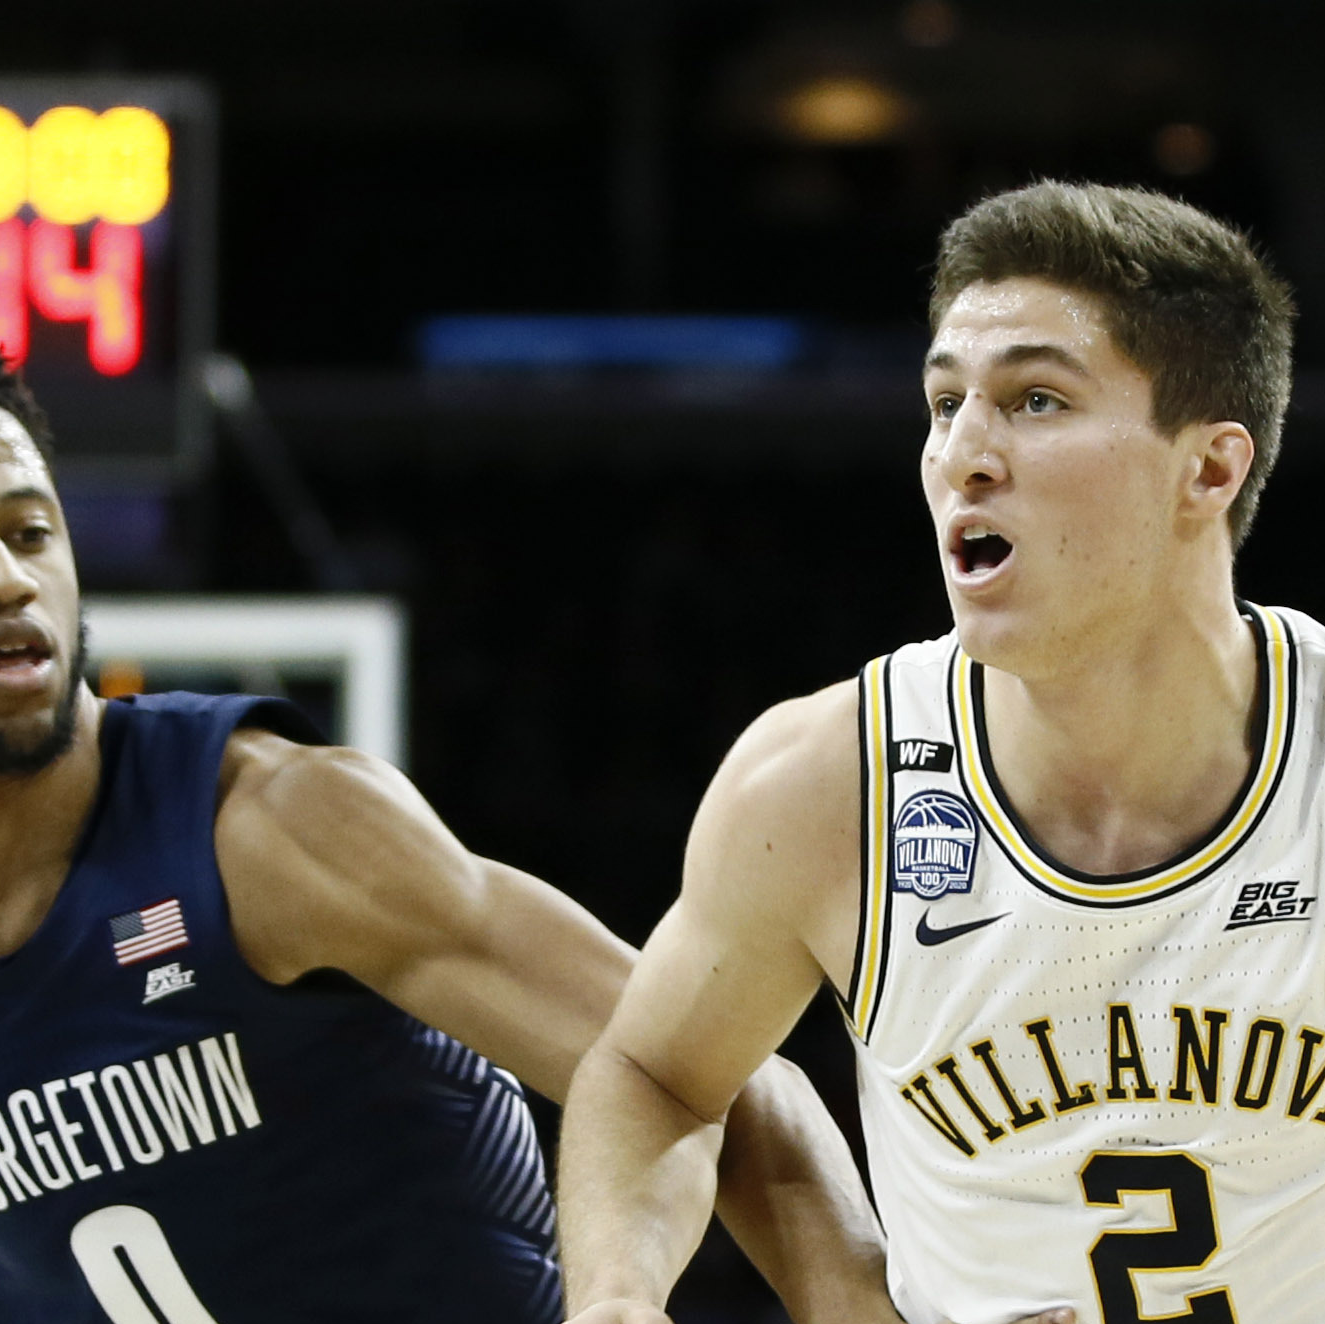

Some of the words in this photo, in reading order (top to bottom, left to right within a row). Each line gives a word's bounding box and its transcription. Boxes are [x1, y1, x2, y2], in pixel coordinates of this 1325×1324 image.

[900, 742, 939, 766] WF
[899, 838, 964, 871] VILLANOVA
[921, 872, 940, 885] 100
[1238, 880, 1300, 901] BIG
[1231, 897, 1317, 920] EAST
